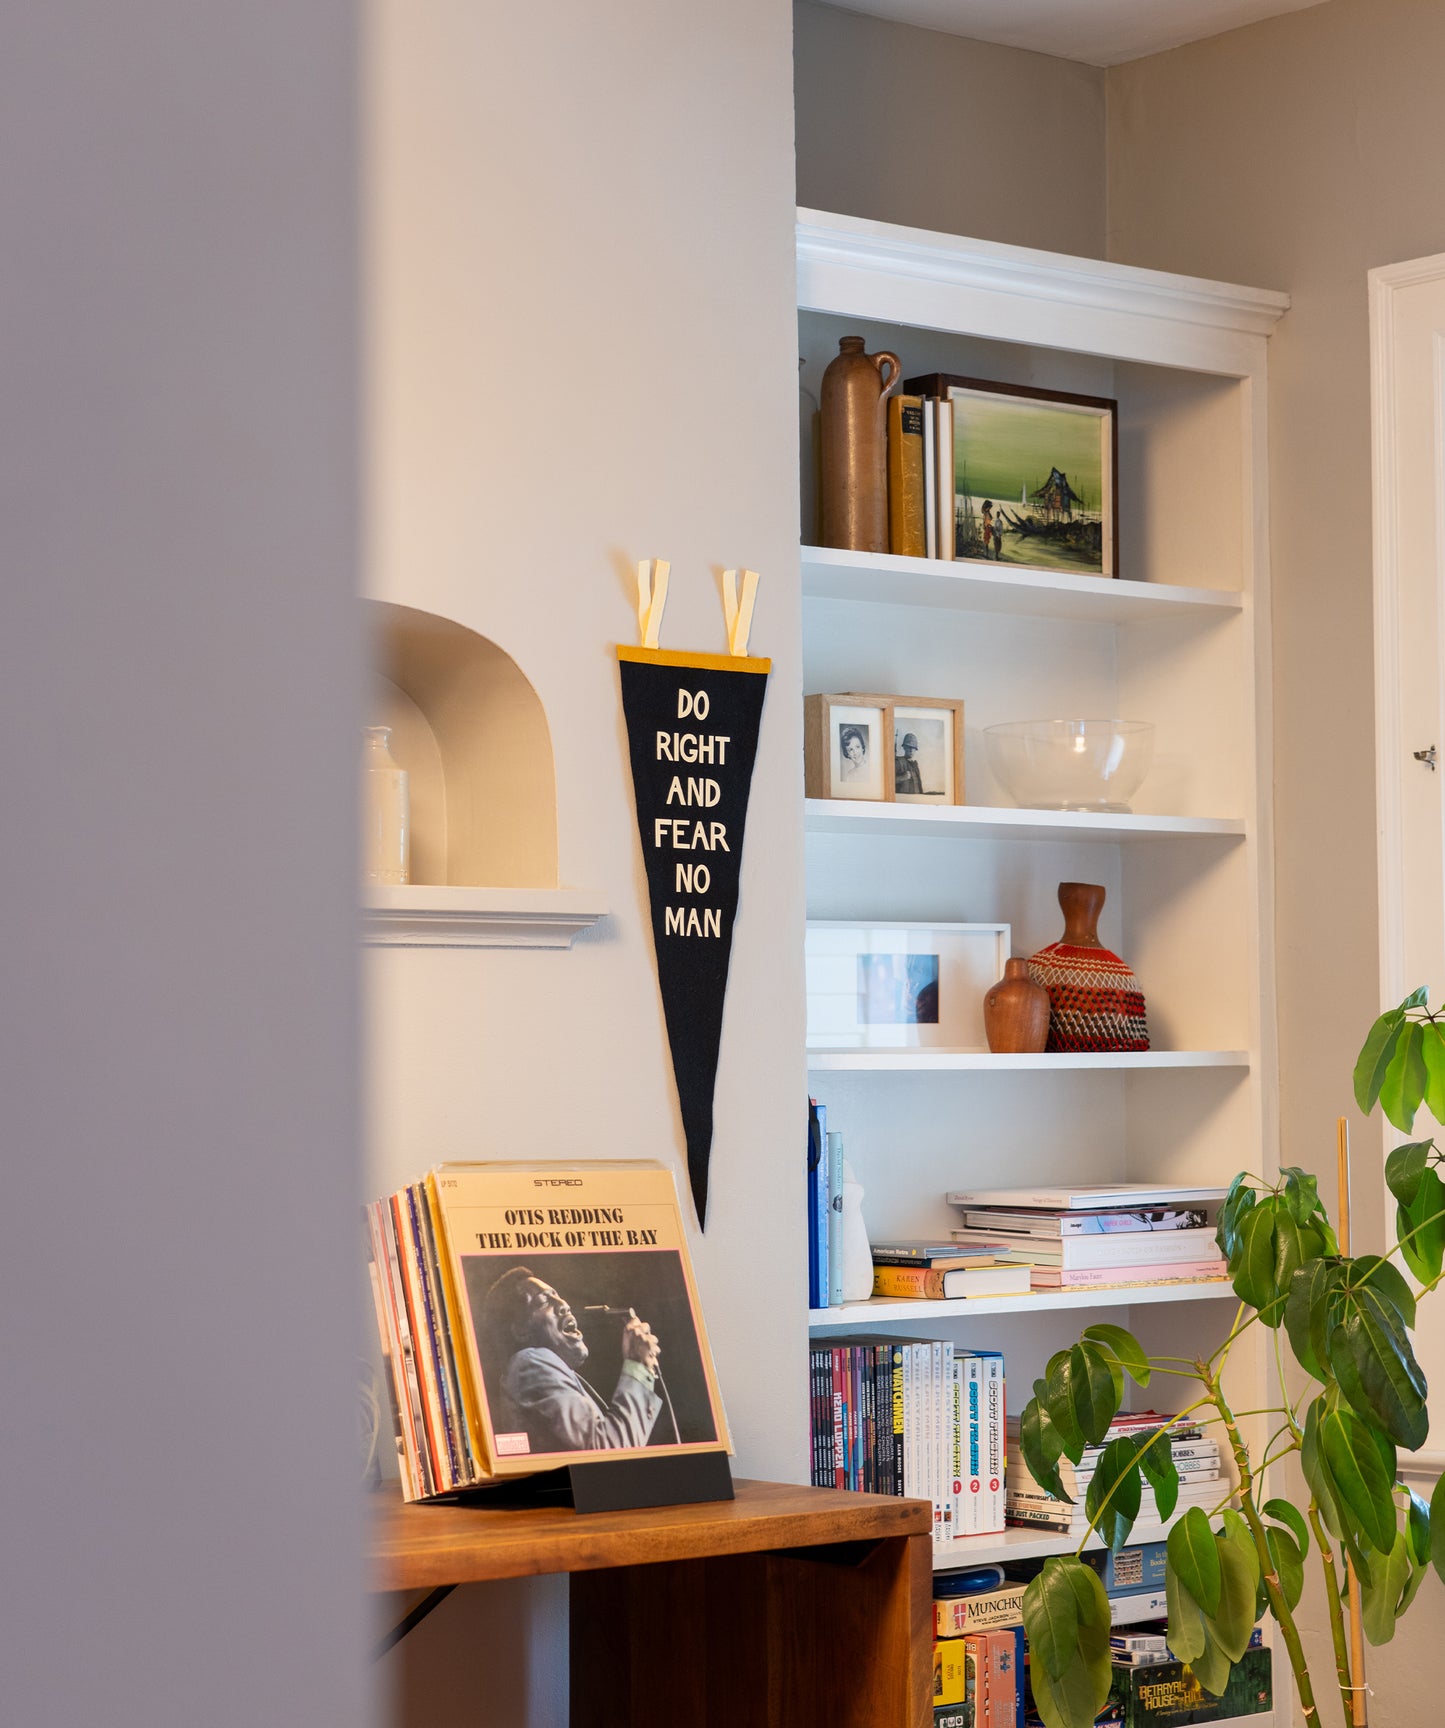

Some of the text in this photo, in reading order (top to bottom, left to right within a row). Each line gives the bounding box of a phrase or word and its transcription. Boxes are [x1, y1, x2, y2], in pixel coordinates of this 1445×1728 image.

[677, 688, 710, 720] DO
[656, 731, 730, 765] RIGHT
[666, 776, 721, 808] AND
[654, 818, 730, 852] FEAR
[676, 864, 711, 894] NO
[665, 906, 722, 938] MAN
[534, 1179, 583, 1187] STEREO
[504, 1208, 624, 1226] OTIS REDDING
[476, 1230, 658, 1249] THE DOCK OF THE BAY
[893, 1367, 903, 1434] WATCHMEN
[969, 1382, 978, 1421] SCOTT
[989, 1381, 998, 1420] SCOTT
[834, 1425, 843, 1468] LOPPER
[970, 1422, 979, 1476] PILGRIM
[990, 1422, 998, 1475] PILGRIM
[973, 1482, 978, 1491] 2
[1029, 1512, 1049, 1520] PACKED
[968, 1596, 1024, 1618] MUNCHKI
[1139, 1681, 1184, 1700] BETRAYAL
[1145, 1694, 1175, 1710] HOUSE
[1184, 1690, 1204, 1704] HILL
